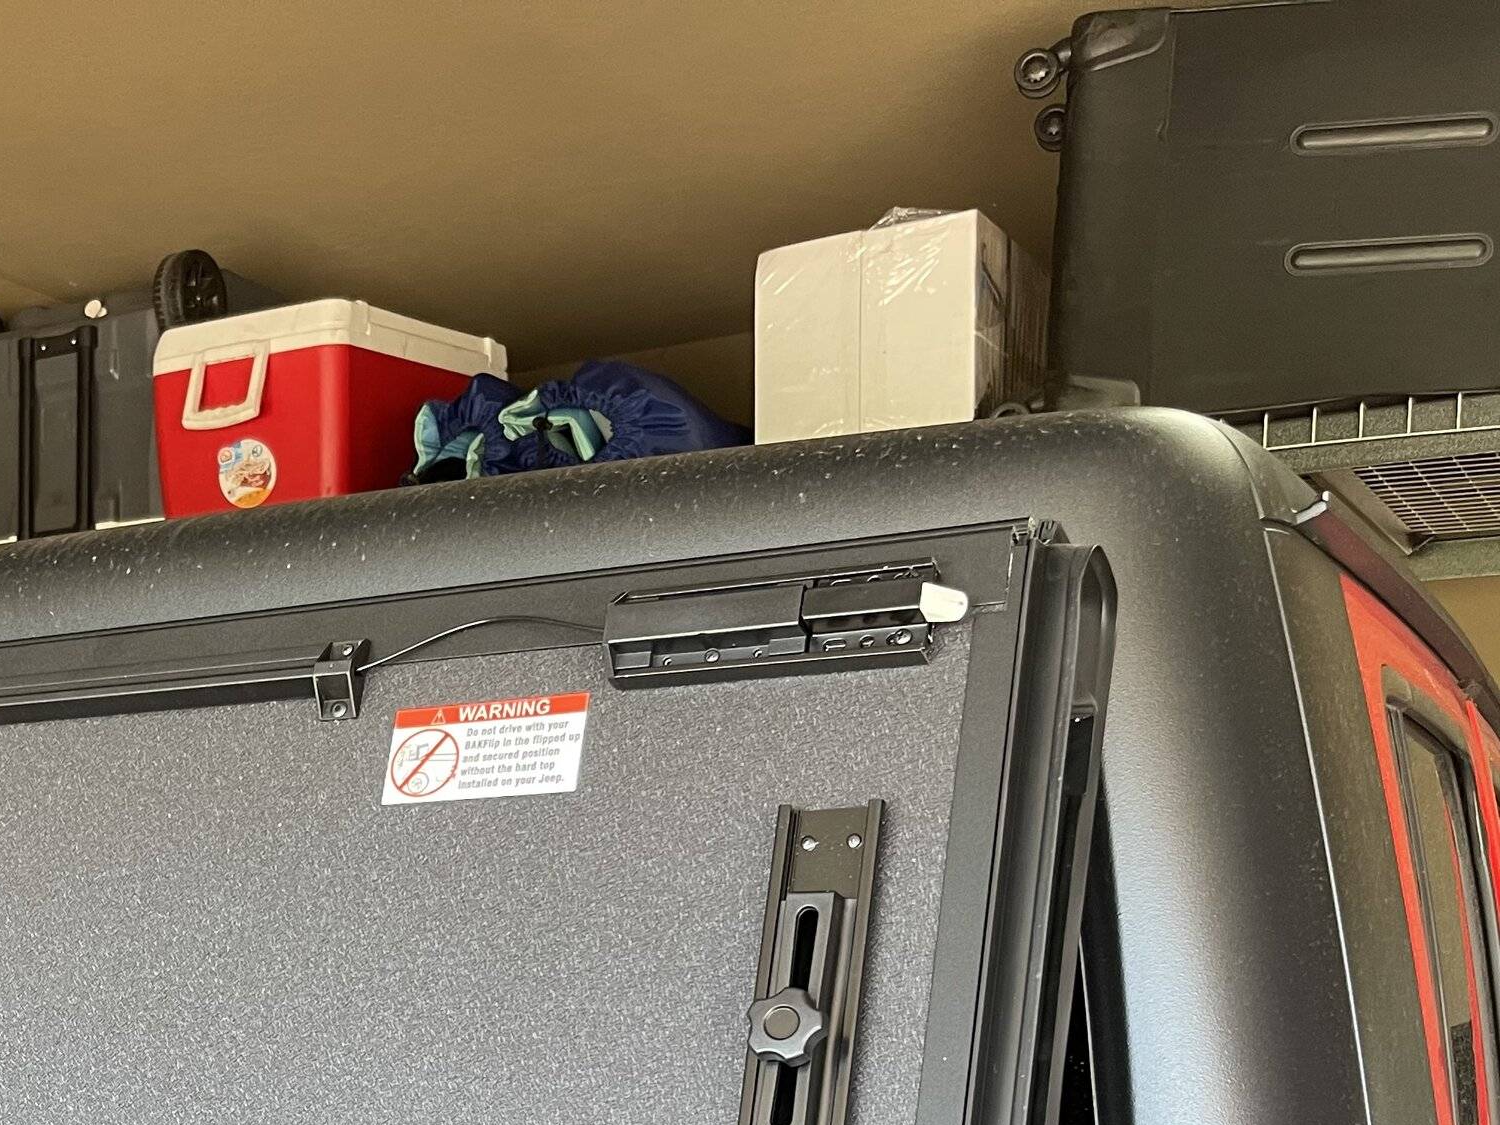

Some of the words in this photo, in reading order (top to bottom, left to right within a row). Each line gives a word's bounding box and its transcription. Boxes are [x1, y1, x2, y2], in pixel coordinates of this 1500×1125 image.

[459, 699, 551, 722] WARNING
[466, 727, 479, 738] Do
[481, 726, 496, 737] not
[498, 724, 523, 735] drive
[525, 721, 545, 732] with
[547, 721, 569, 733] your
[464, 738, 501, 751] BAKFlip
[502, 737, 512, 748] in
[514, 736, 530, 747] the
[532, 733, 566, 745] flipped
[568, 732, 581, 743] up
[462, 752, 480, 764] and
[482, 749, 520, 762] secured
[521, 747, 561, 760] position
[460, 764, 495, 777] without
[497, 762, 513, 774] the
[515, 761, 537, 772] hard
[539, 760, 555, 772] top
[457, 777, 499, 790] installed
[500, 776, 512, 787] on
[514, 775, 536, 788] your
[538, 773, 565, 786] Jeep.
